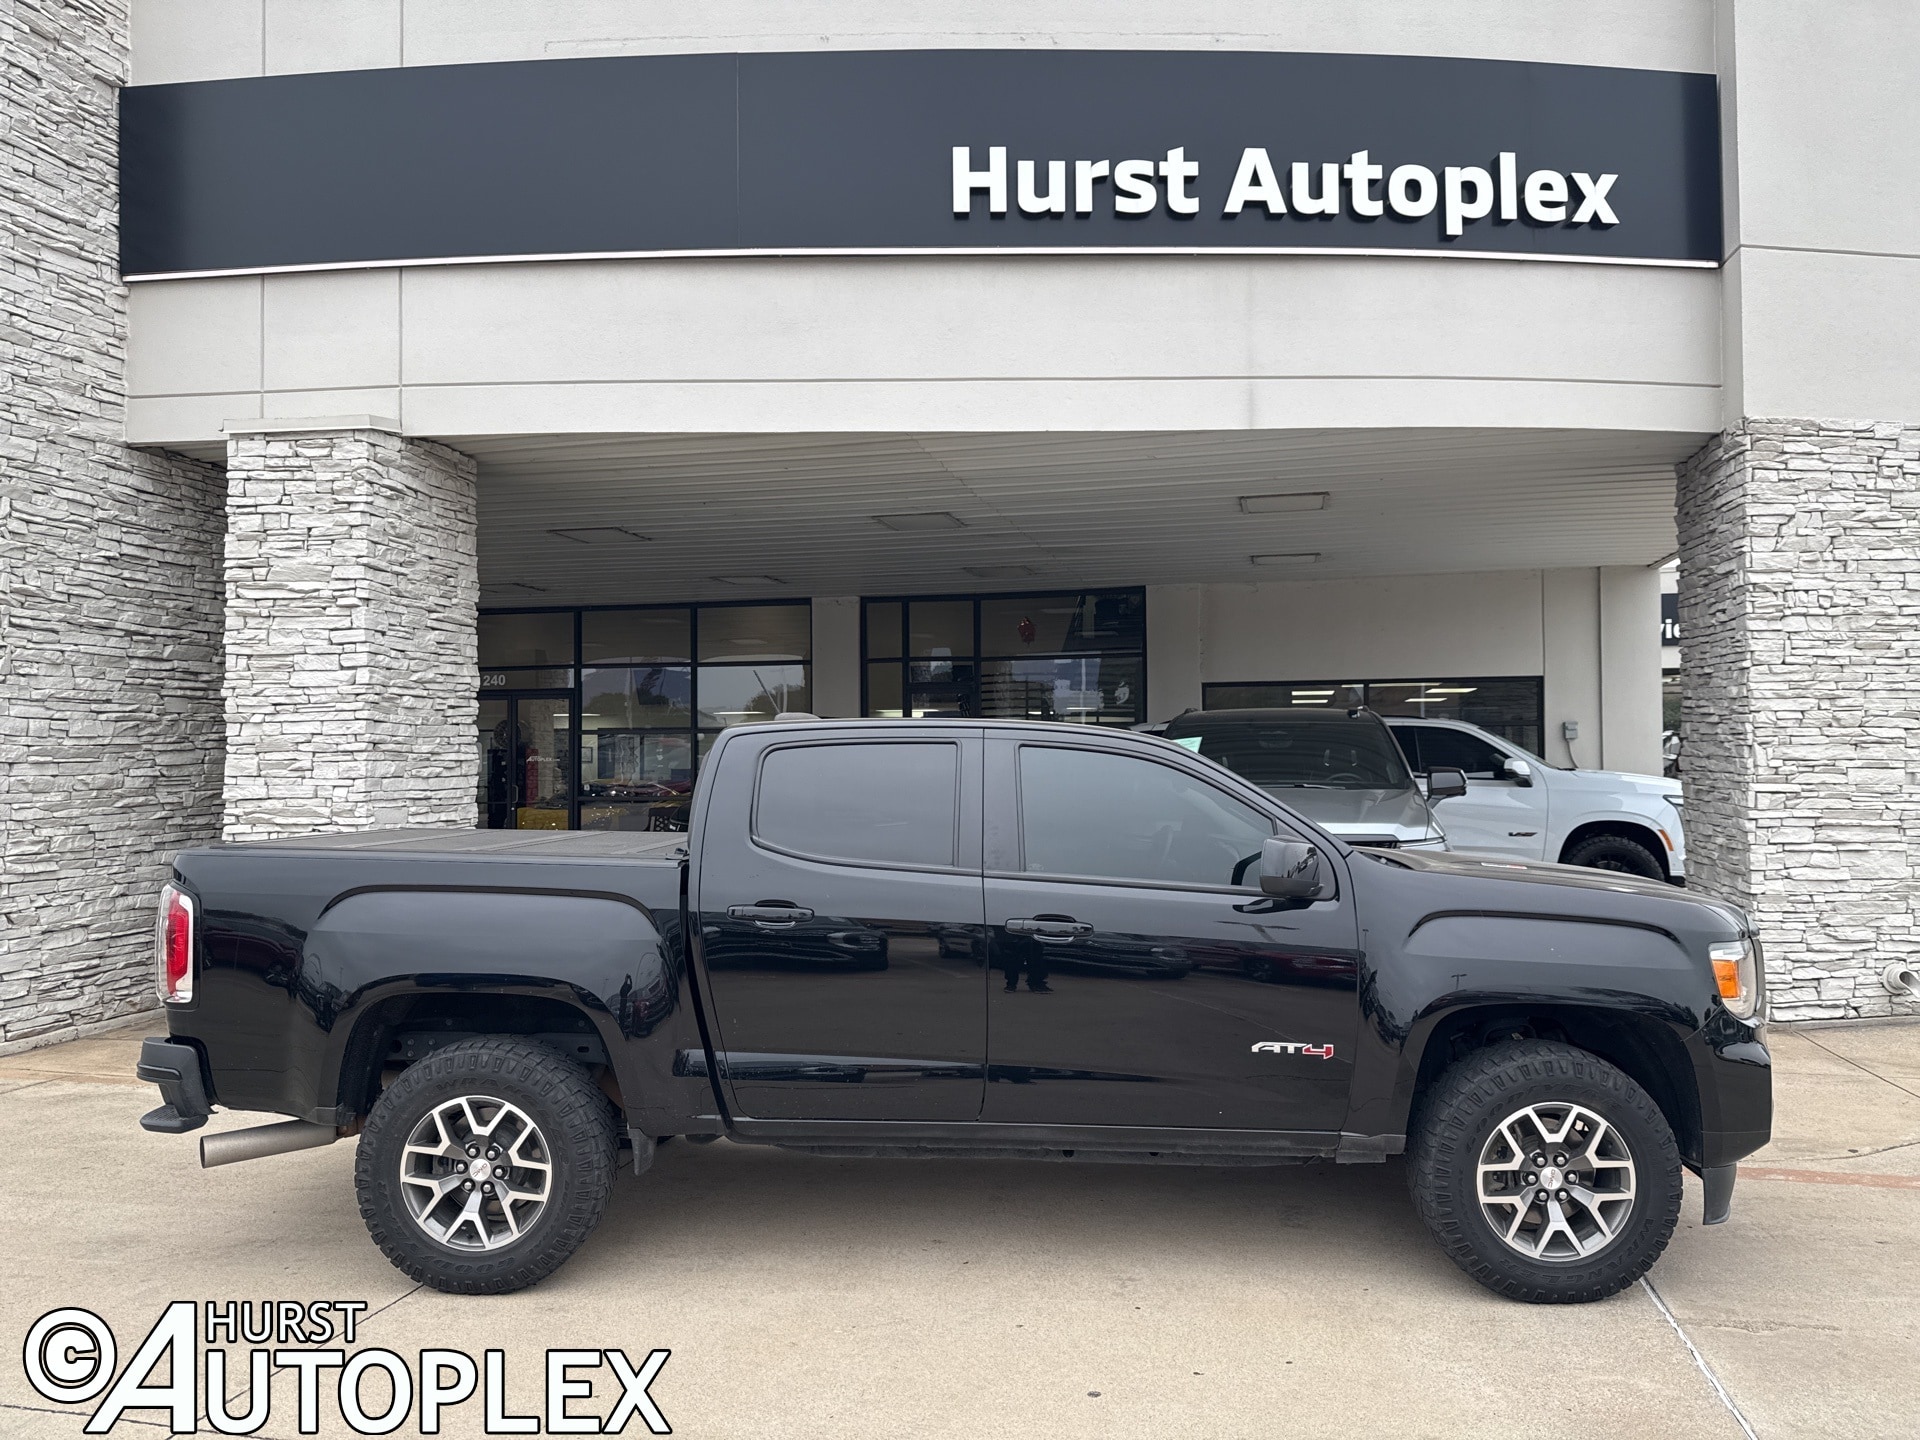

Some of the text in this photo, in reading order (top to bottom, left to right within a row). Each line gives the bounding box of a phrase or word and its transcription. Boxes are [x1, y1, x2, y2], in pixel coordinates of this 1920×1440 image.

[952, 146, 1620, 236] Hurst Autoplex
[482, 674, 506, 686] 240
[1251, 1041, 1334, 1060] AT4
